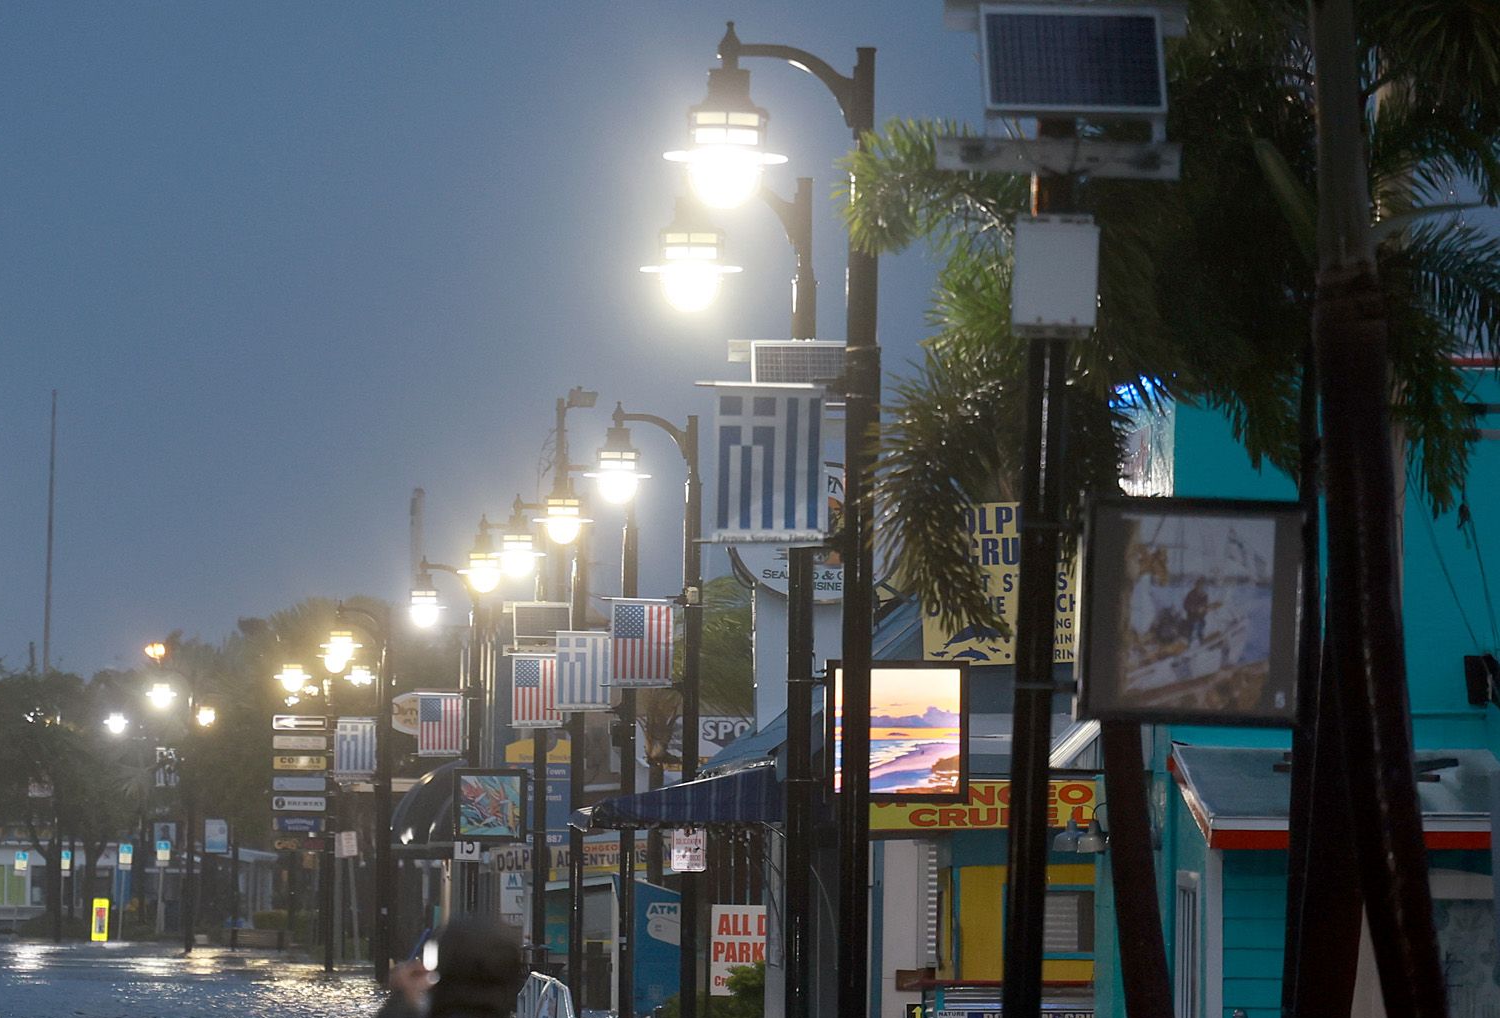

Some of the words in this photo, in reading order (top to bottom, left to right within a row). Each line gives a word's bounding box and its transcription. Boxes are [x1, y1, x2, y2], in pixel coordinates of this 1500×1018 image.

[822, 570, 834, 580] &
[649, 904, 677, 915] ATM
[718, 913, 752, 936] ALL
